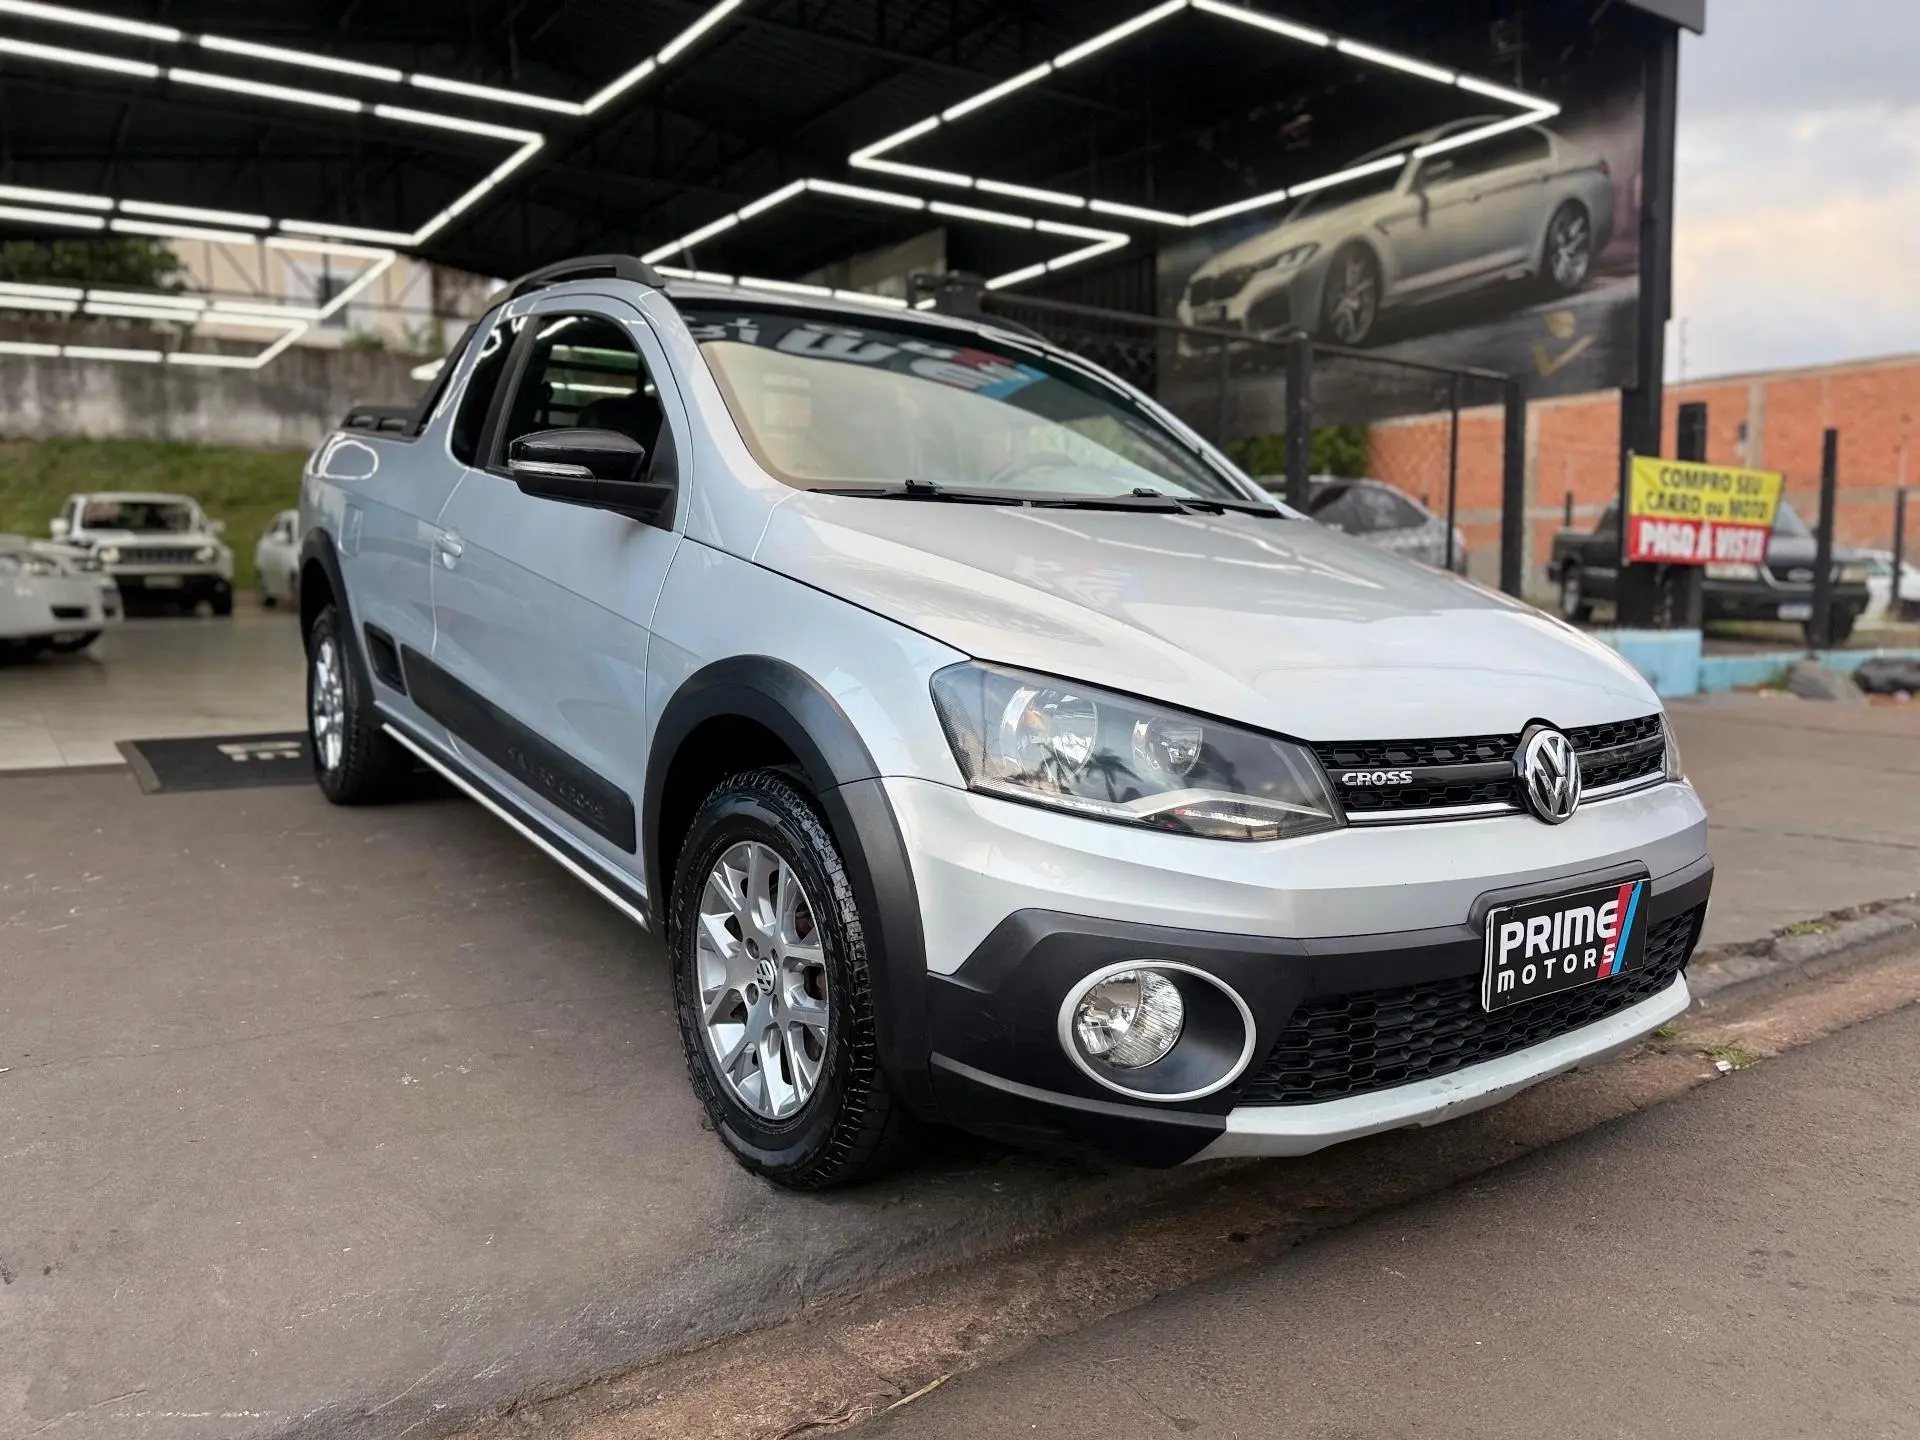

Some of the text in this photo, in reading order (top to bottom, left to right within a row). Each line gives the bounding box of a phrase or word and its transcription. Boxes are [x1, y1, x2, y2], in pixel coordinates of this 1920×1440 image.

[1660, 466, 1763, 495] COMPRO SEU
[1646, 490, 1701, 516] CARRO
[1729, 497, 1768, 520] MOTO
[1639, 521, 1694, 558] PAGO
[1715, 527, 1765, 561] VISTA
[1341, 770, 1413, 786] CROSS
[1498, 899, 1619, 966] PRIME
[1496, 942, 1616, 994] MOTORS
